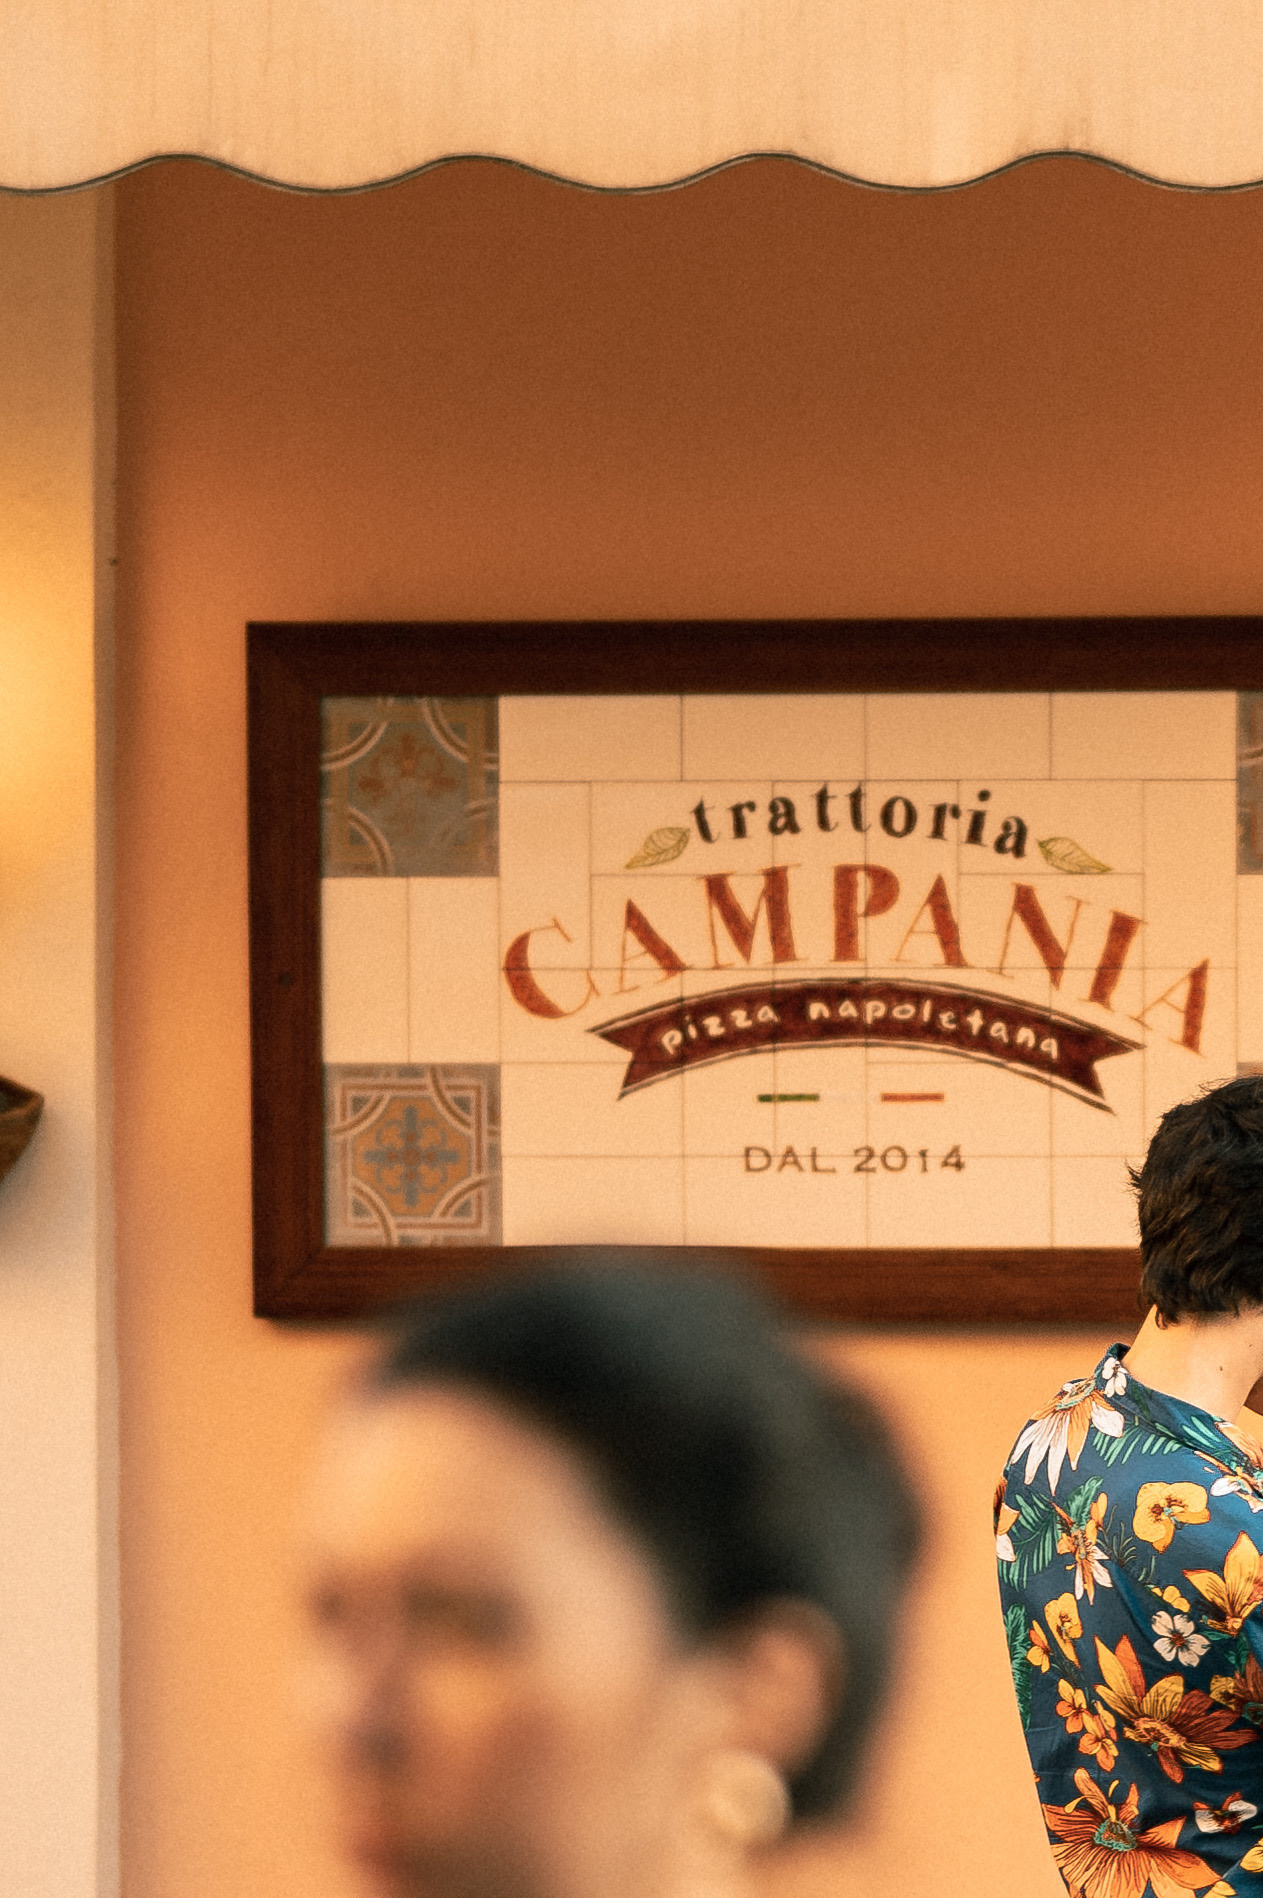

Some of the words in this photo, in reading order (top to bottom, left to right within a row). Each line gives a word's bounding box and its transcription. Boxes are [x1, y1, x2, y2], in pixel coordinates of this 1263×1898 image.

[690, 782, 1027, 860] trattoria
[502, 863, 1211, 1055] CAMPANIA
[661, 1004, 779, 1054] pizza
[808, 999, 1059, 1059] napoletana
[744, 1146, 836, 1174] DAL
[853, 1146, 966, 1174] 2014
